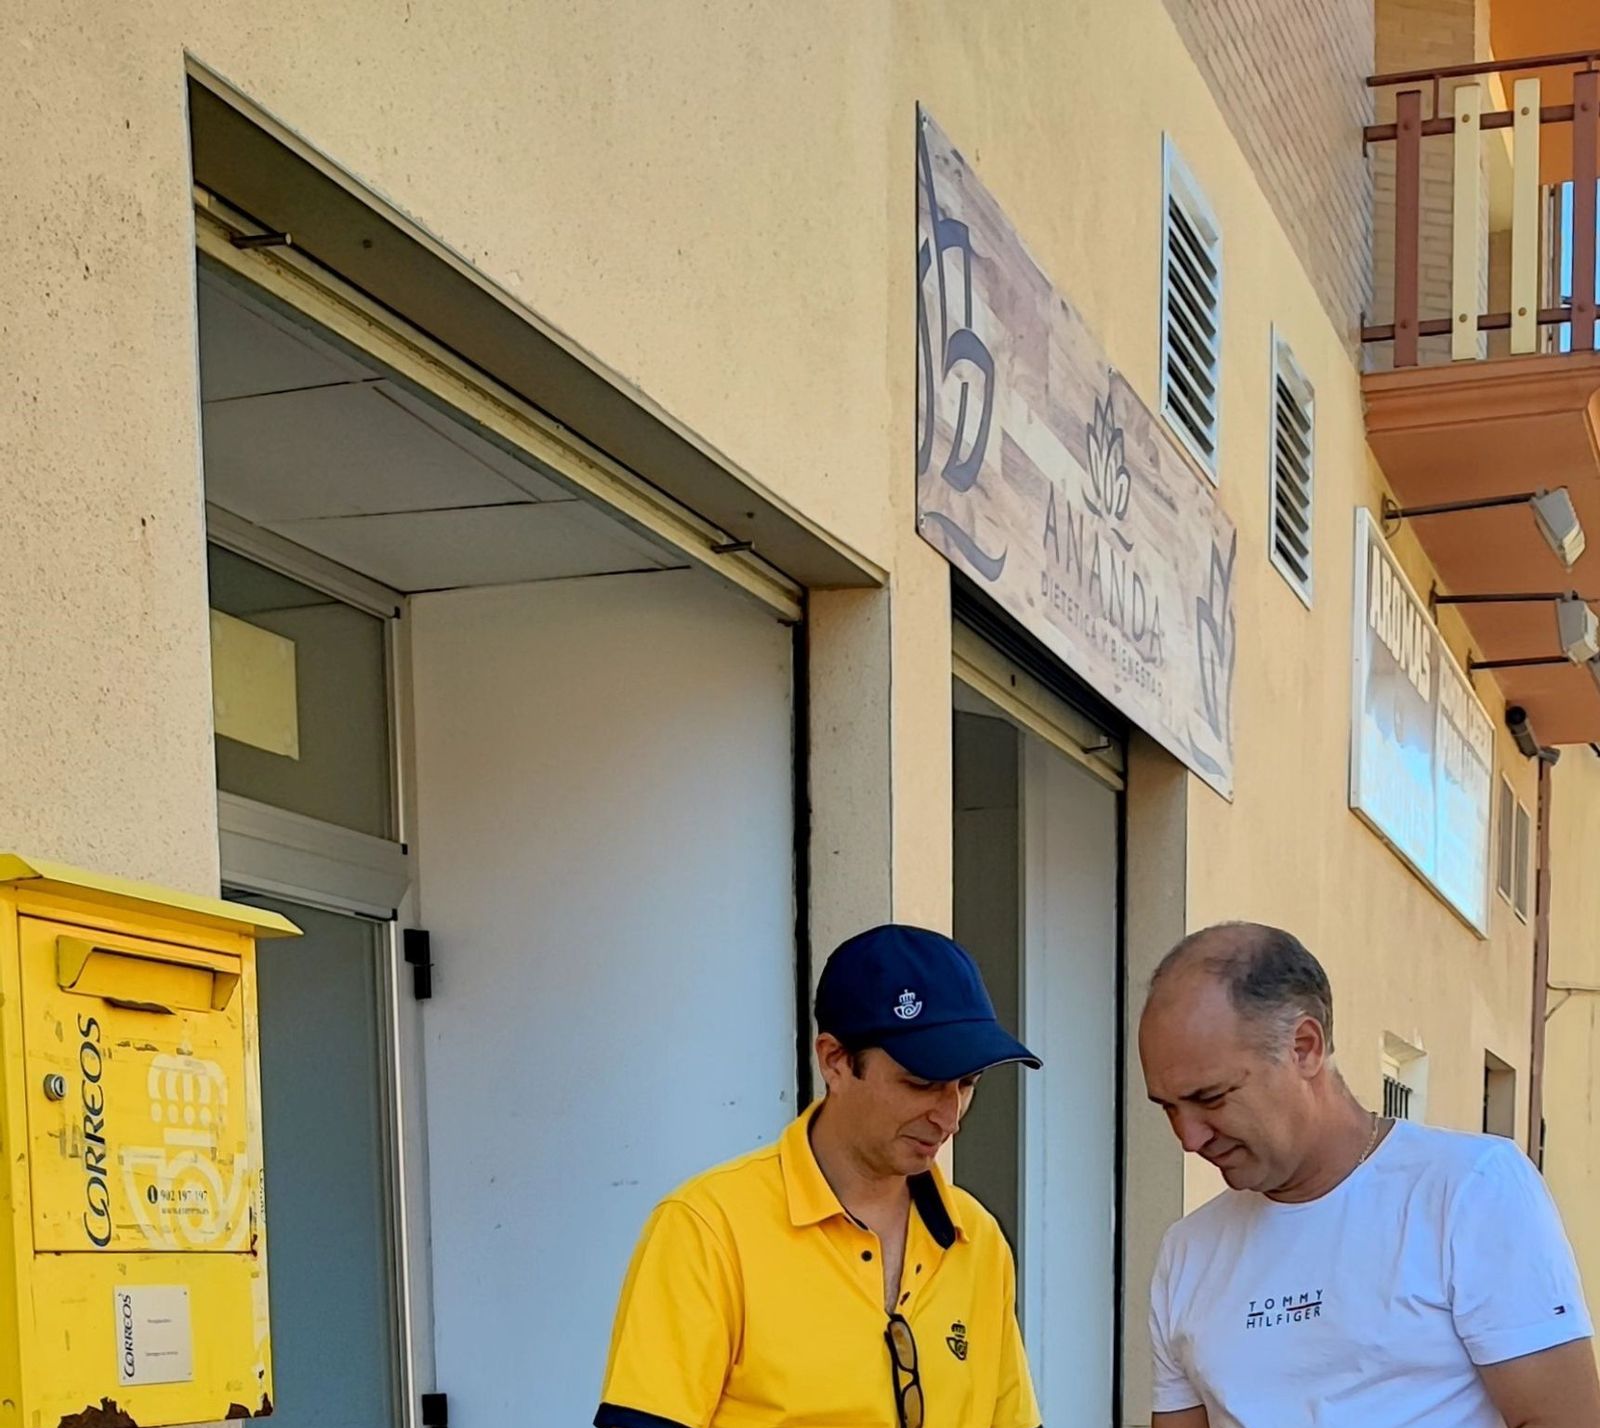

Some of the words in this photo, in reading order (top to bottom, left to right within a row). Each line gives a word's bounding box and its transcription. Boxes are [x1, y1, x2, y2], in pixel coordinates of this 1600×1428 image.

[1043, 481, 1164, 668] ANANDA
[1369, 545, 1431, 703] AROMAS
[77, 1012, 112, 1248] CORREOS
[122, 1295, 135, 1378] CORREOS
[1246, 1306, 1321, 1329] HILFIGER
[1249, 1289, 1323, 1312] TOMMY
